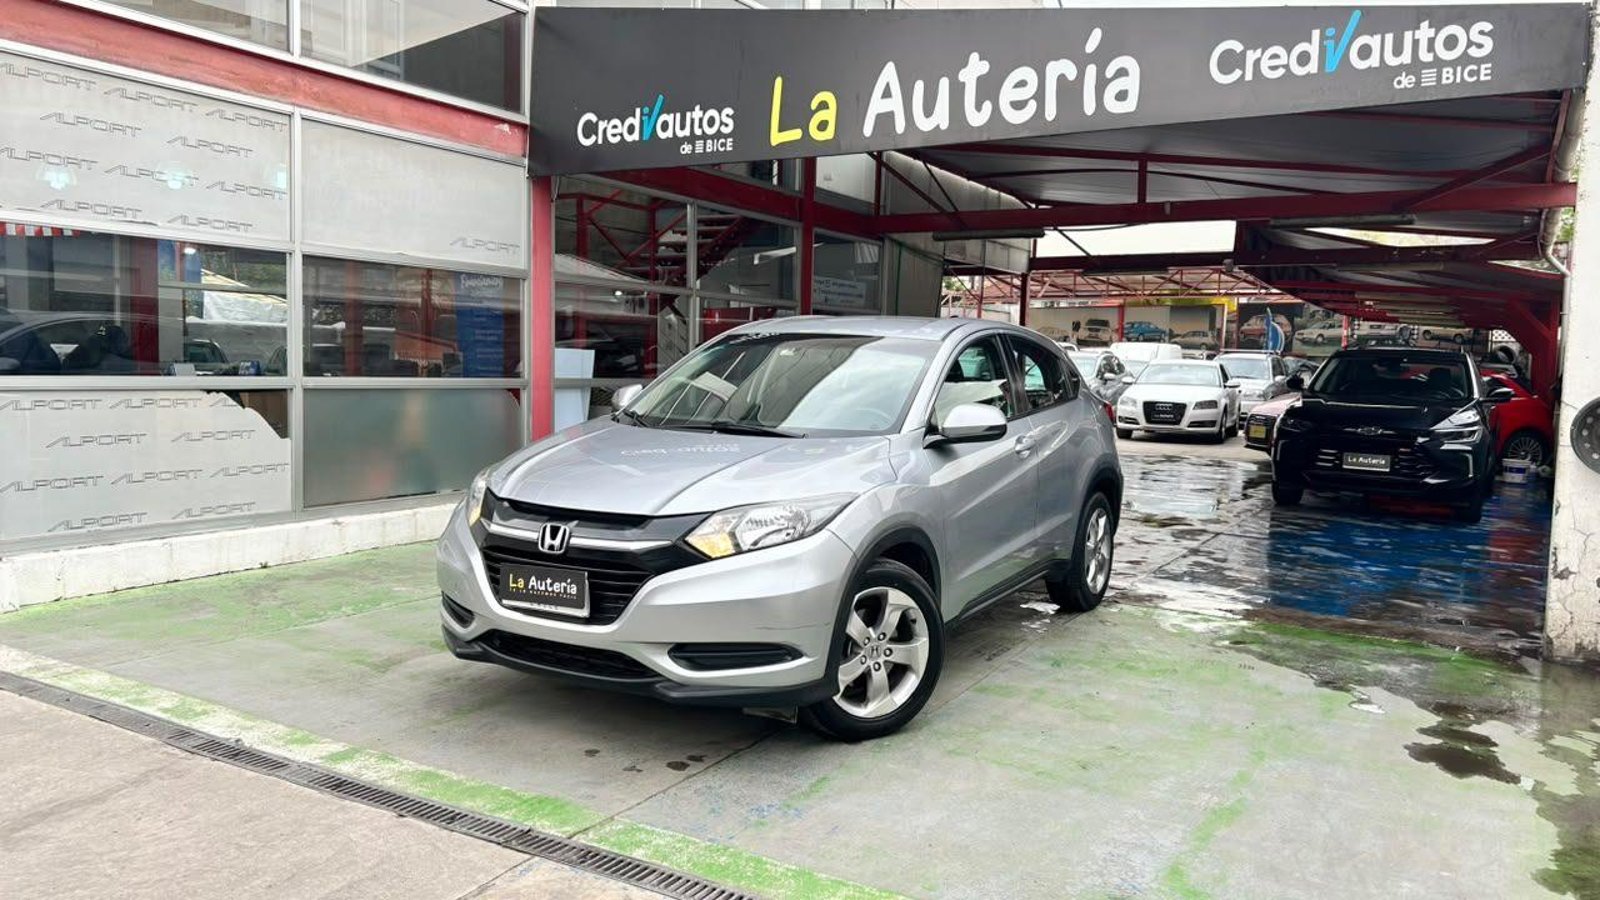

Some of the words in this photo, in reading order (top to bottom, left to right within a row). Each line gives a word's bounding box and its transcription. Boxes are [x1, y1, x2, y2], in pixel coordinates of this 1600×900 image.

[769, 76, 837, 147] La
[862, 28, 1140, 138] Autería
[1393, 70, 1416, 89] de
[1441, 63, 1492, 85] BICE
[680, 141, 693, 154] de
[705, 138, 734, 153] BICE
[509, 573, 525, 588] La
[528, 575, 577, 595] Autería
